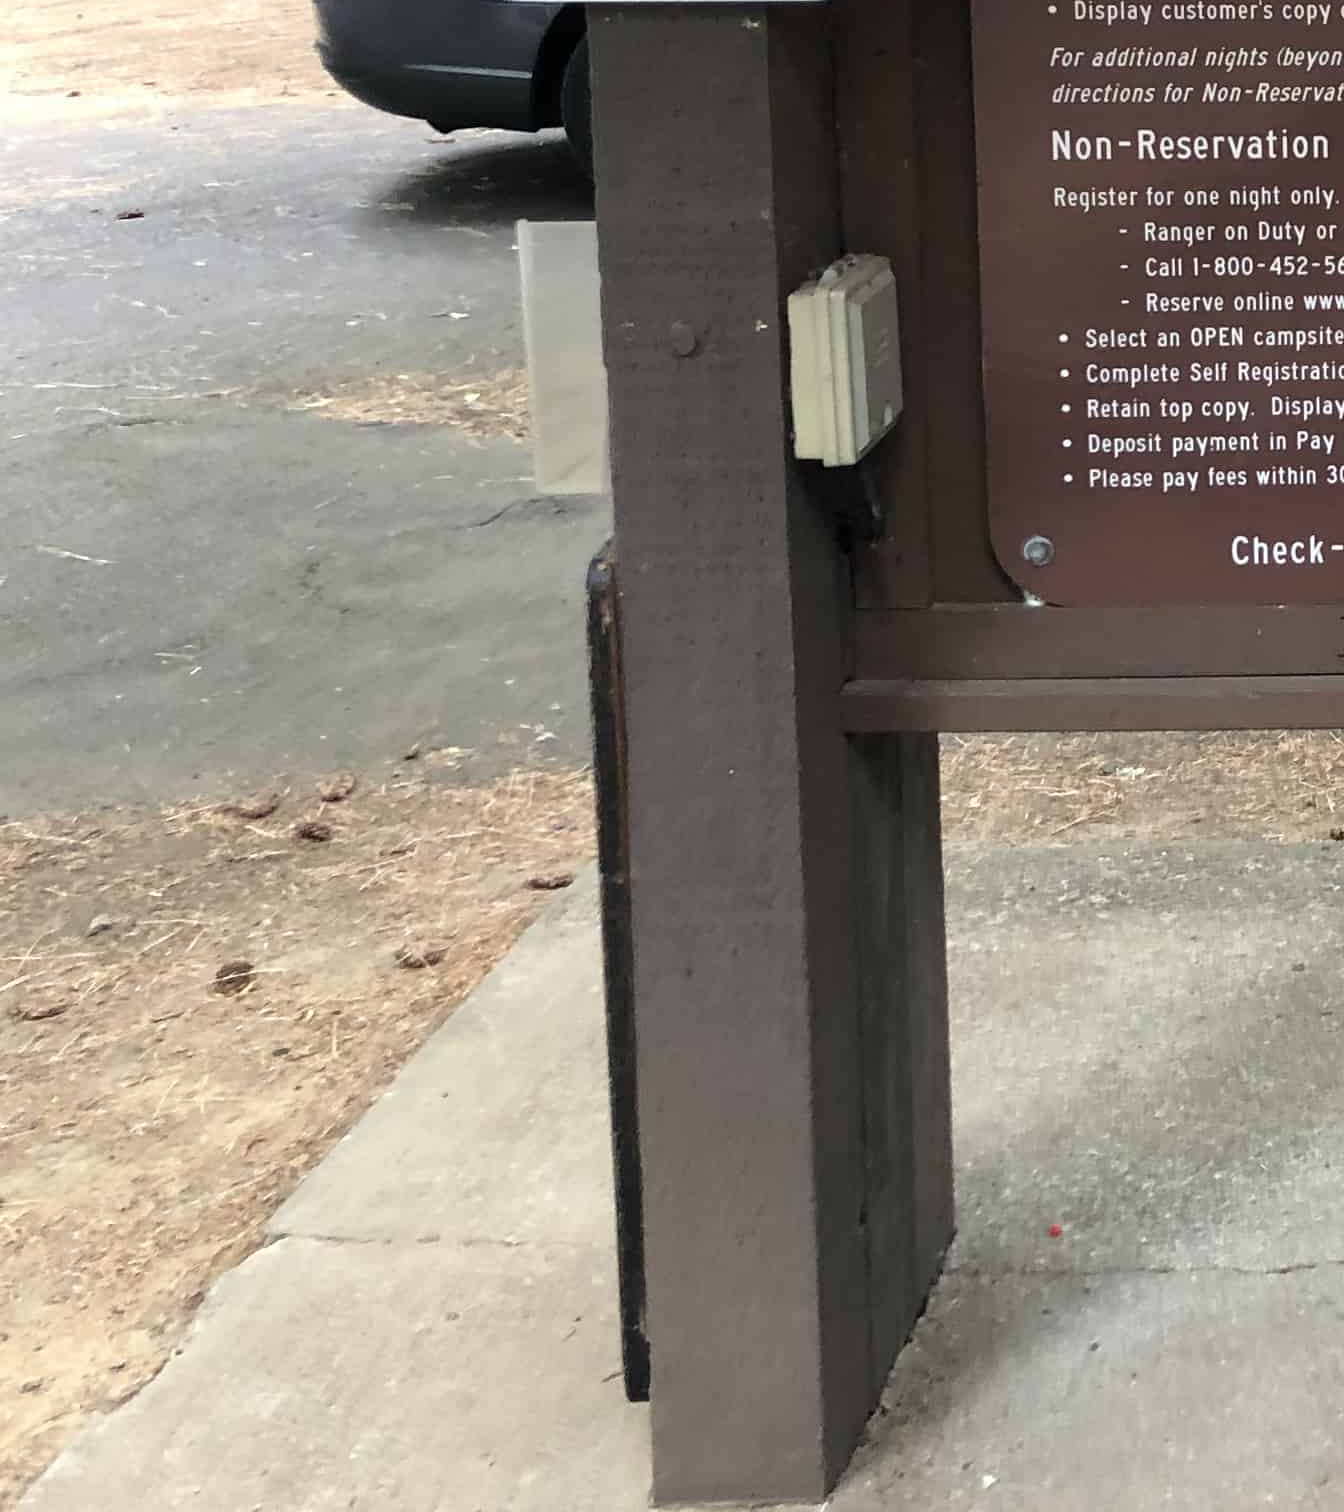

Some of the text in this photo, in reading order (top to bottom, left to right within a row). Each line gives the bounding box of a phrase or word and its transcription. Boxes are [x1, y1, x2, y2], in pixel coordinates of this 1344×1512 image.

[1052, 128, 1329, 161] Non-Reservation
[1144, 220, 1337, 247] Ranger on Duty or
[1145, 257, 1183, 277] Call
[1146, 292, 1224, 313] Reserve
[1233, 291, 1294, 312] online
[1085, 328, 1147, 348] Select
[1157, 331, 1180, 348] an
[1190, 326, 1244, 347] OPEN
[1253, 325, 1344, 352] campsite
